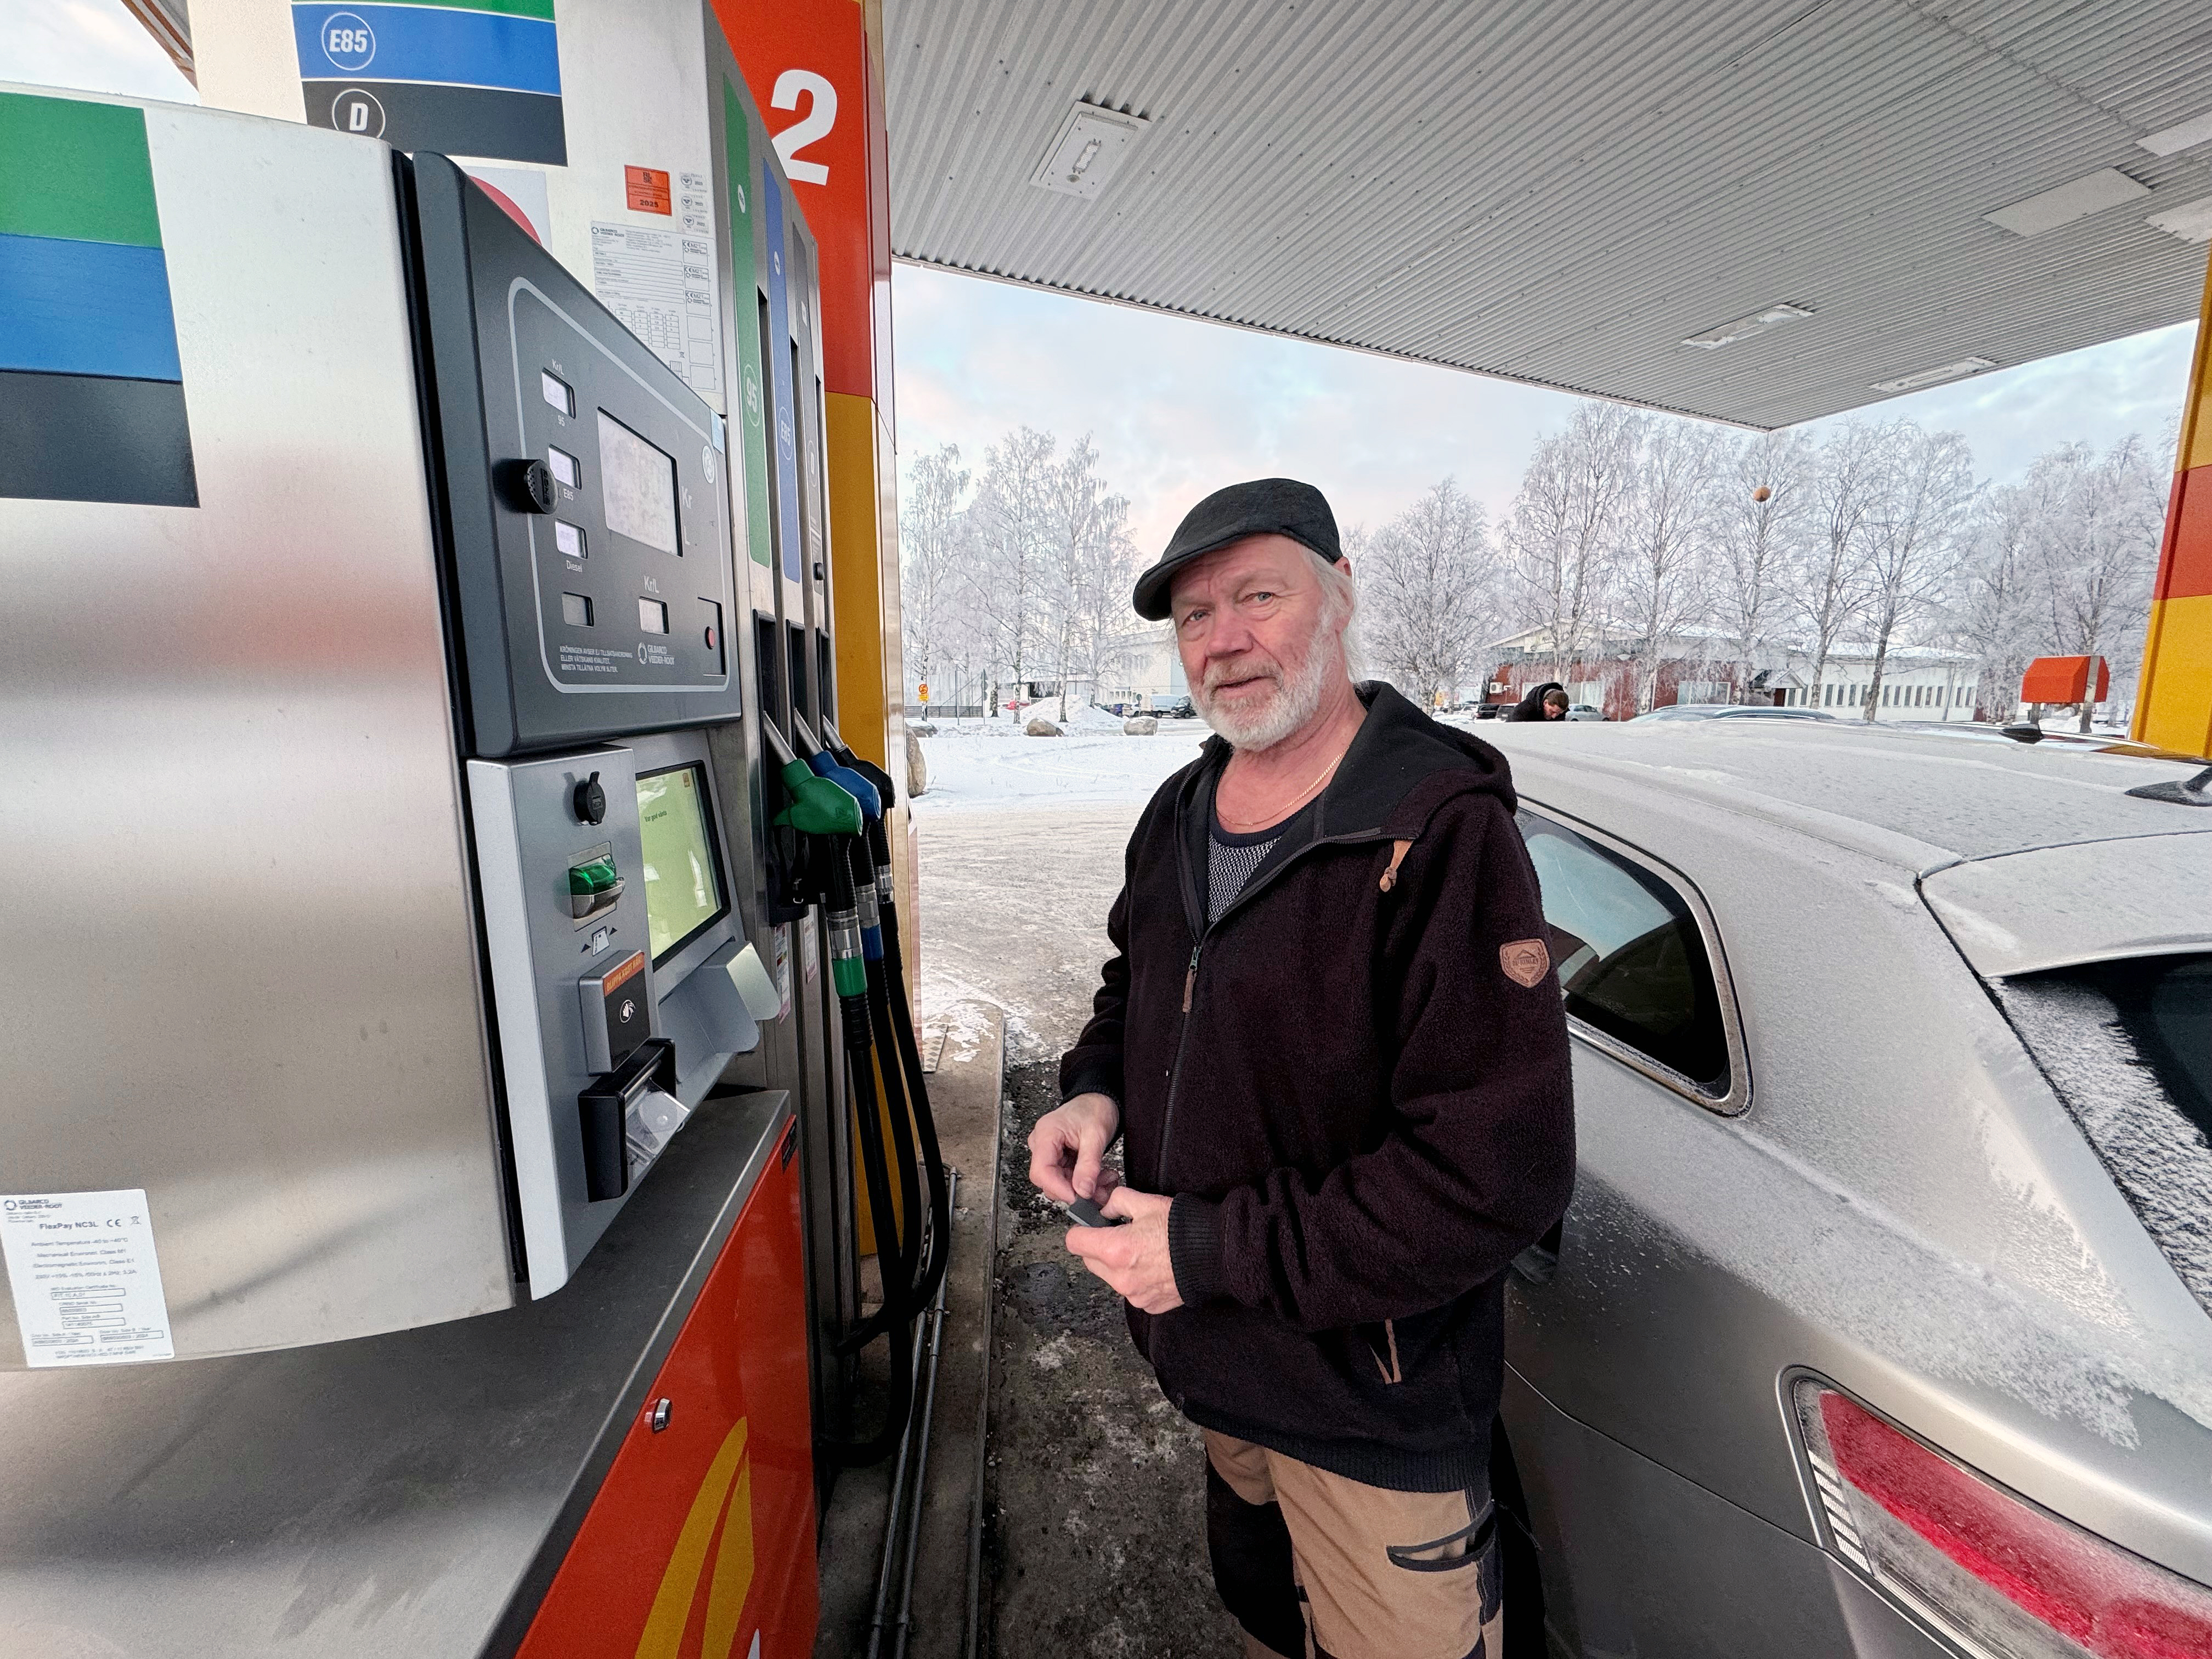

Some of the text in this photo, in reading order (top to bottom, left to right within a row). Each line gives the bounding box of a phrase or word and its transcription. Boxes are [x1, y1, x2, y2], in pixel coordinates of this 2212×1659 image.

[329, 29, 368, 53] E85
[349, 103, 369, 131] D
[770, 69, 838, 186] 2
[640, 199, 659, 208] 2025
[746, 376, 758, 413] 95
[557, 414, 565, 427] 95
[563, 488, 574, 501] E85
[681, 486, 692, 510] Kr
[566, 560, 583, 573] Diesel
[643, 574, 659, 594] Kr/L
